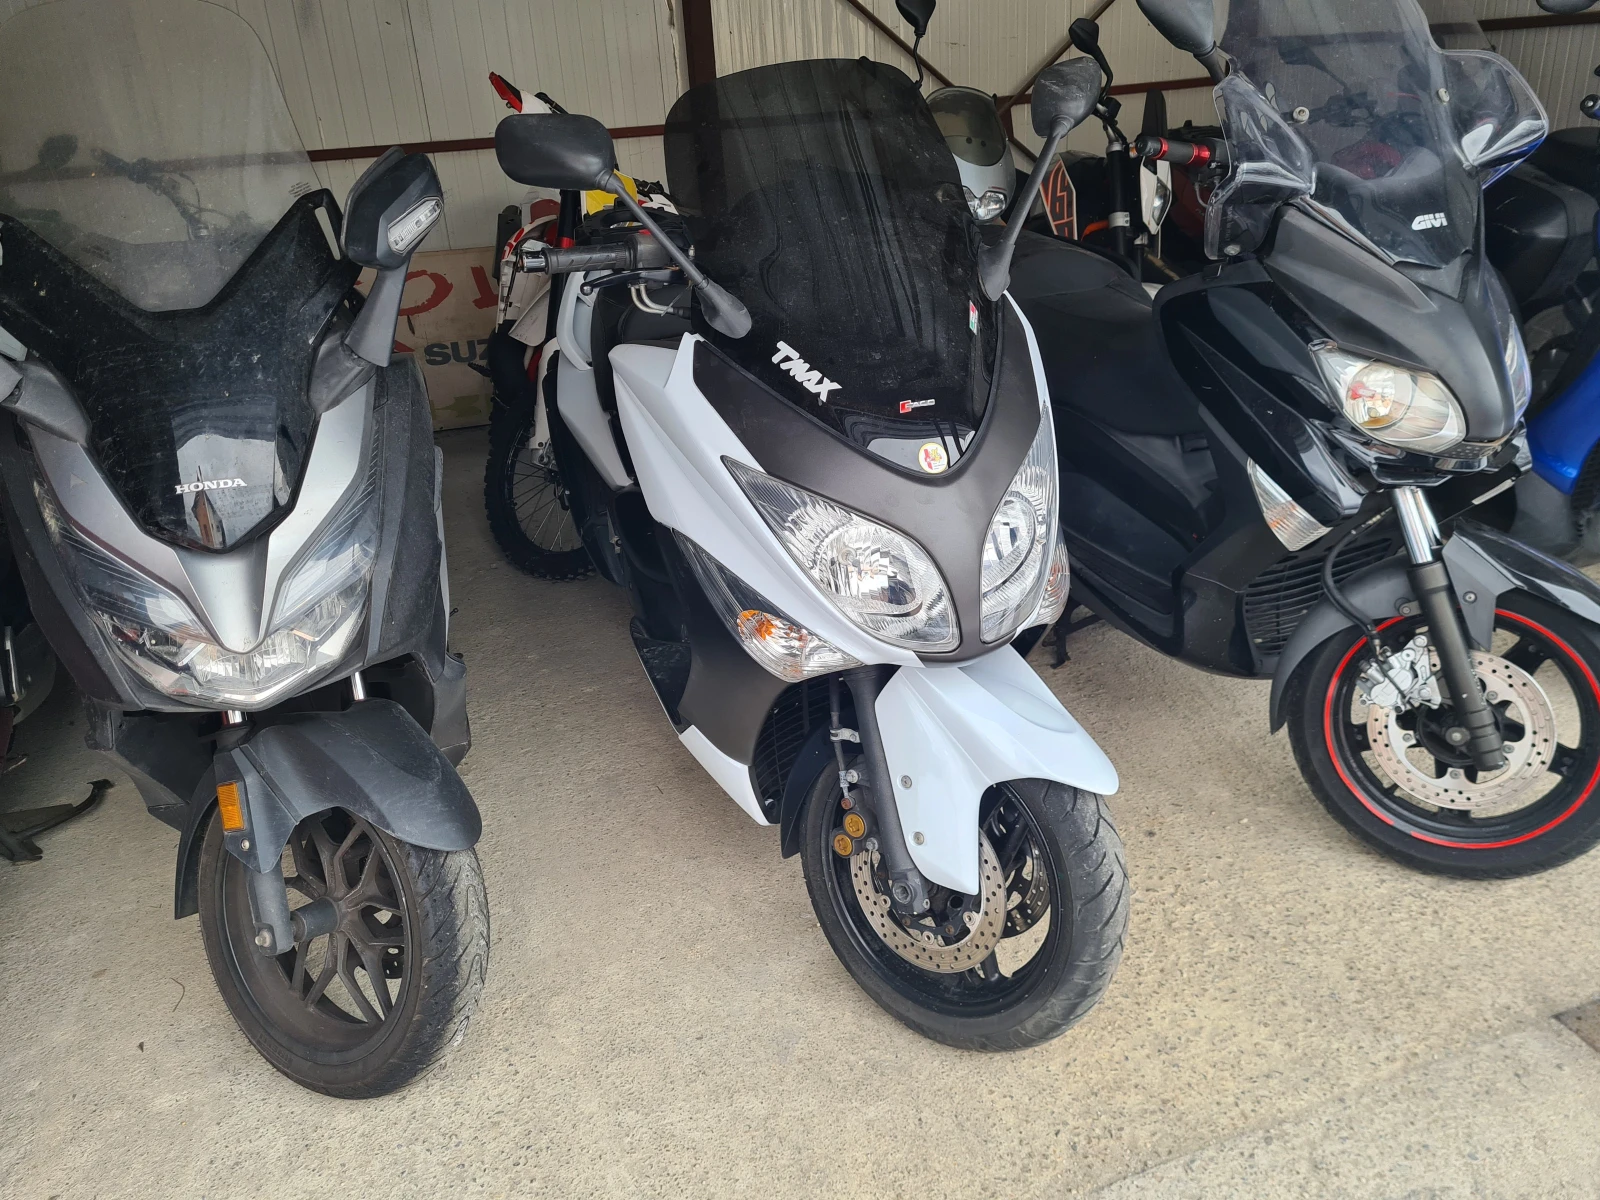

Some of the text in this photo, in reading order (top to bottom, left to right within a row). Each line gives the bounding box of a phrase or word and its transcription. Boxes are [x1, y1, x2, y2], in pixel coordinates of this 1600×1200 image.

[1411, 212, 1448, 230] GIVI
[771, 340, 843, 402] TMAX
[175, 478, 247, 494] HONDA
